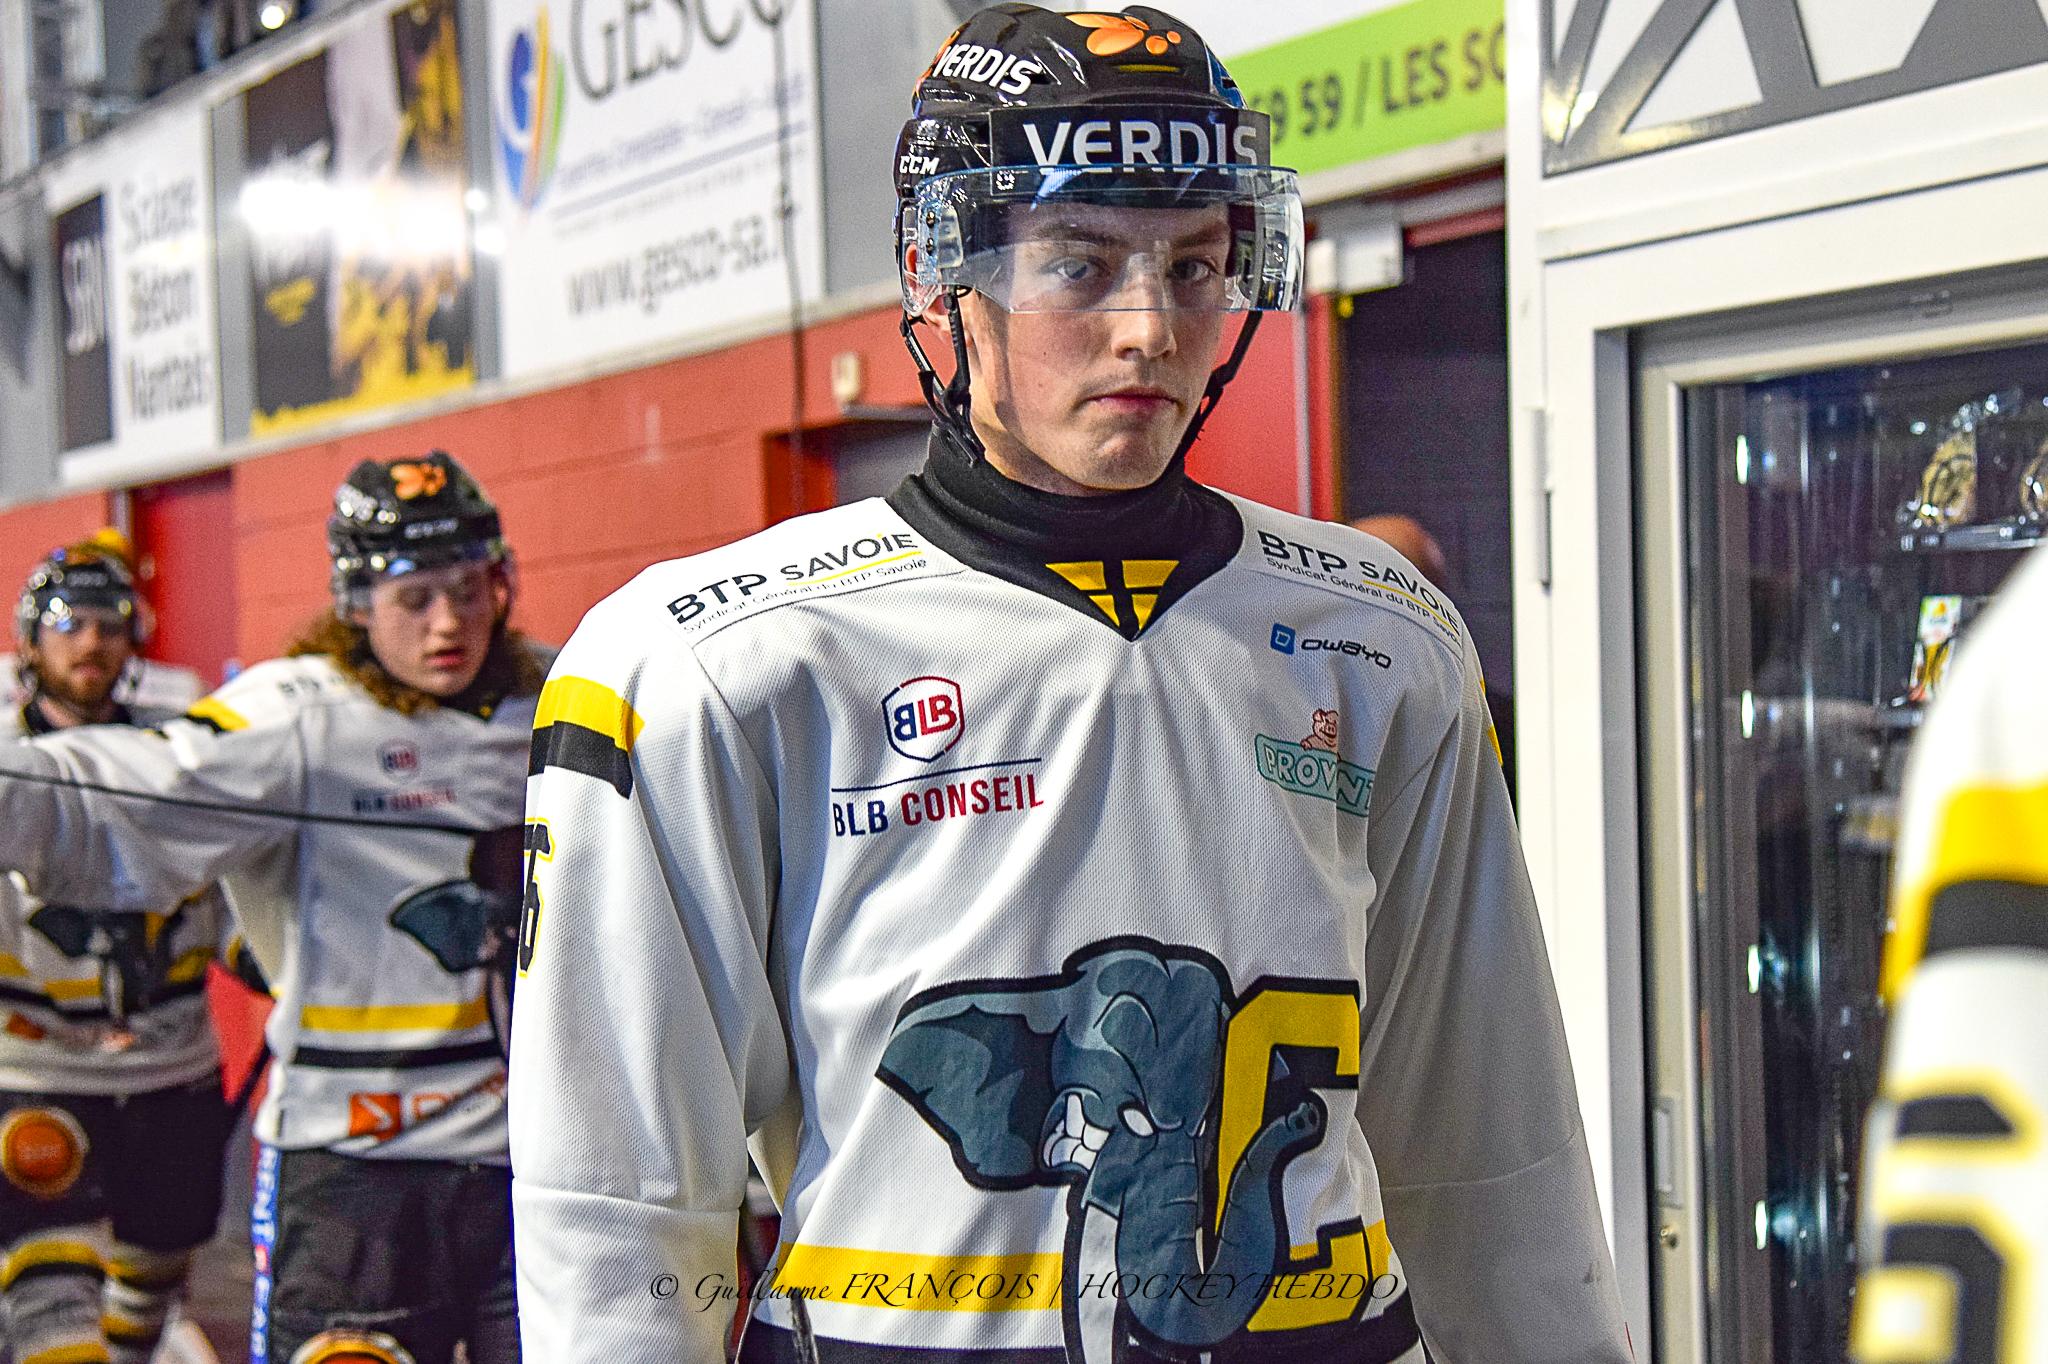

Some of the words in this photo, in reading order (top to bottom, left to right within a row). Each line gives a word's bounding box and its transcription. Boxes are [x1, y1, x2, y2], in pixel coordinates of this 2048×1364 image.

[931, 43, 1043, 96] VERDIS
[1380, 38, 1452, 114] LES
[900, 155, 940, 175] CCM
[1023, 120, 1258, 176] VERDIS
[1258, 530, 1347, 573] BTP
[666, 573, 767, 625] BTP
[1267, 557, 1326, 582] Syndicat
[1330, 575, 1382, 599] Général
[1385, 592, 1404, 606] du
[1406, 599, 1431, 619] BTP
[1301, 638, 1392, 669] owayo
[1264, 742, 1374, 812] PROVN
[832, 800, 889, 837] BLB
[900, 774, 1044, 826] CONSEIL
